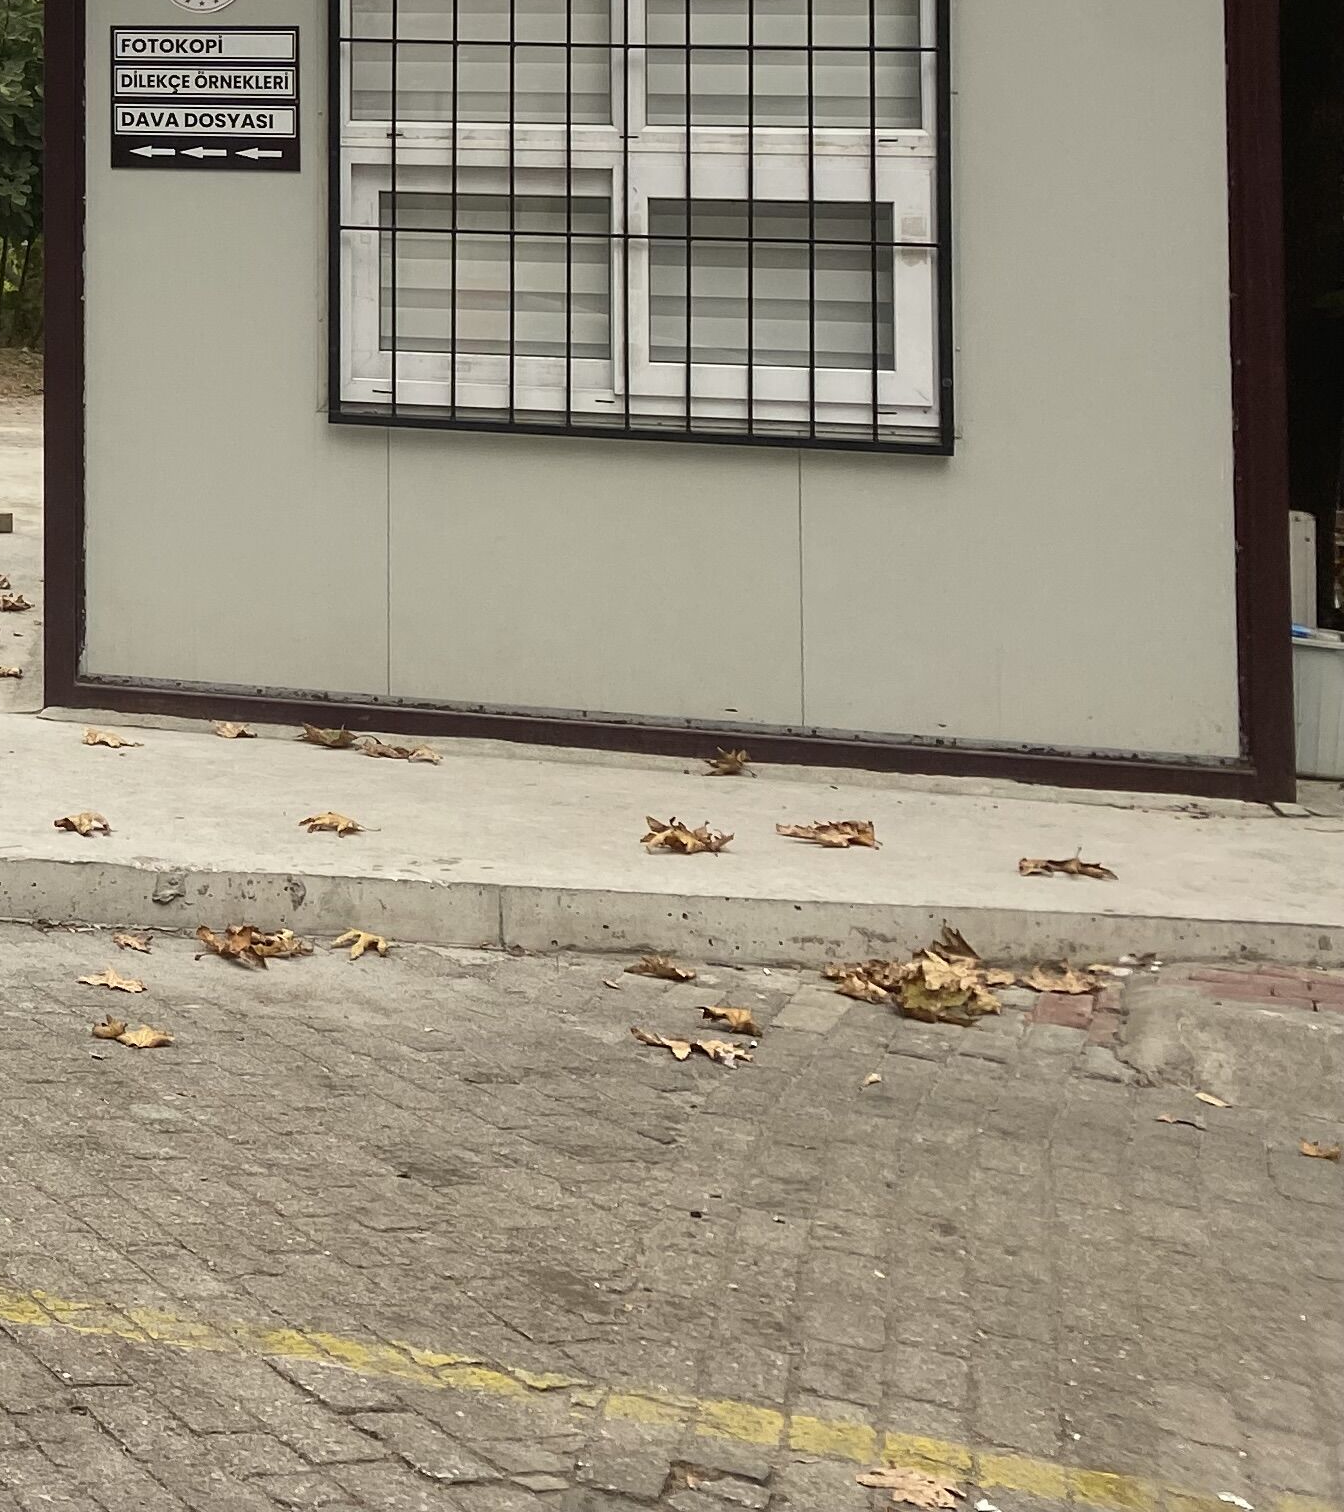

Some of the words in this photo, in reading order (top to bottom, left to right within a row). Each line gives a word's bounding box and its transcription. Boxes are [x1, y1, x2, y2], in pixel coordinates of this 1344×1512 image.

[121, 34, 223, 54] FOTOKOPİ
[121, 71, 190, 94] DİLEKÇE
[194, 70, 289, 90] ÖRNEKLERİ
[121, 111, 179, 129] DAVA
[185, 112, 274, 130] DOSYASI
